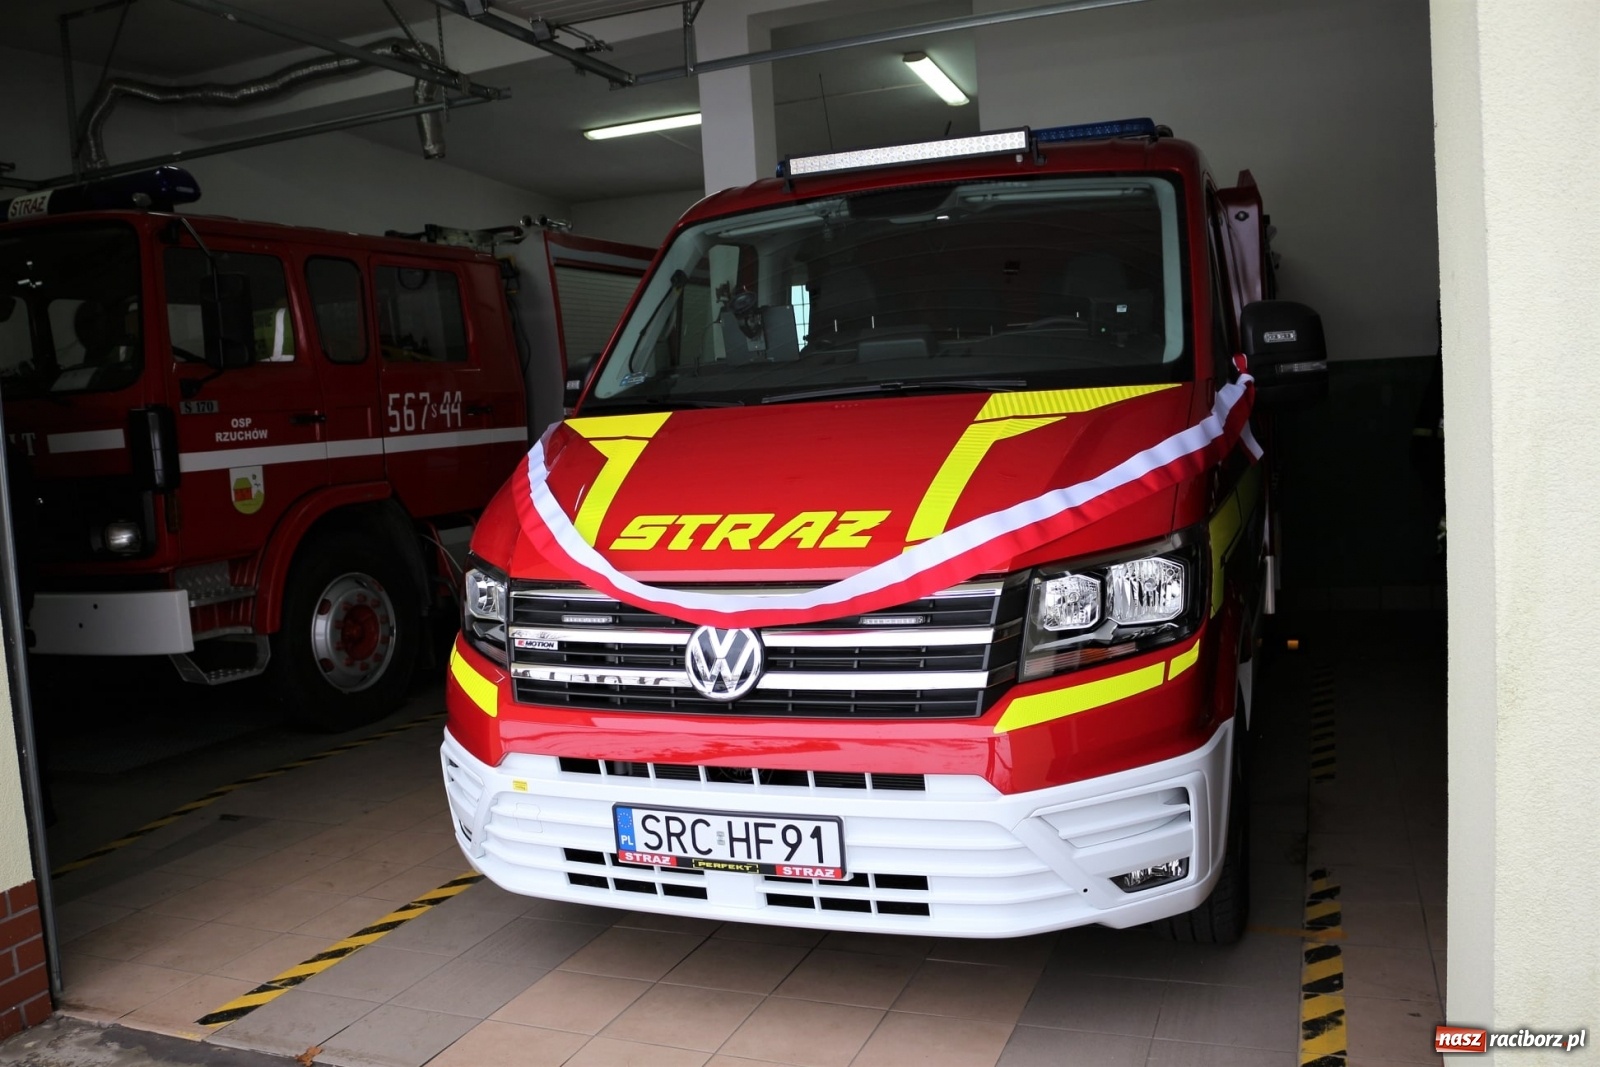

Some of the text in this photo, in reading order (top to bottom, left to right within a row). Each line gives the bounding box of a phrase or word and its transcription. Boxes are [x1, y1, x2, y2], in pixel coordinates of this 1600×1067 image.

[196, 401, 214, 412] 170
[230, 417, 253, 428] OSP
[215, 427, 268, 442] RZUCHÓW
[620, 834, 634, 846] PL
[641, 814, 824, 864] SRC HF91
[697, 861, 753, 871] PERFEKT
